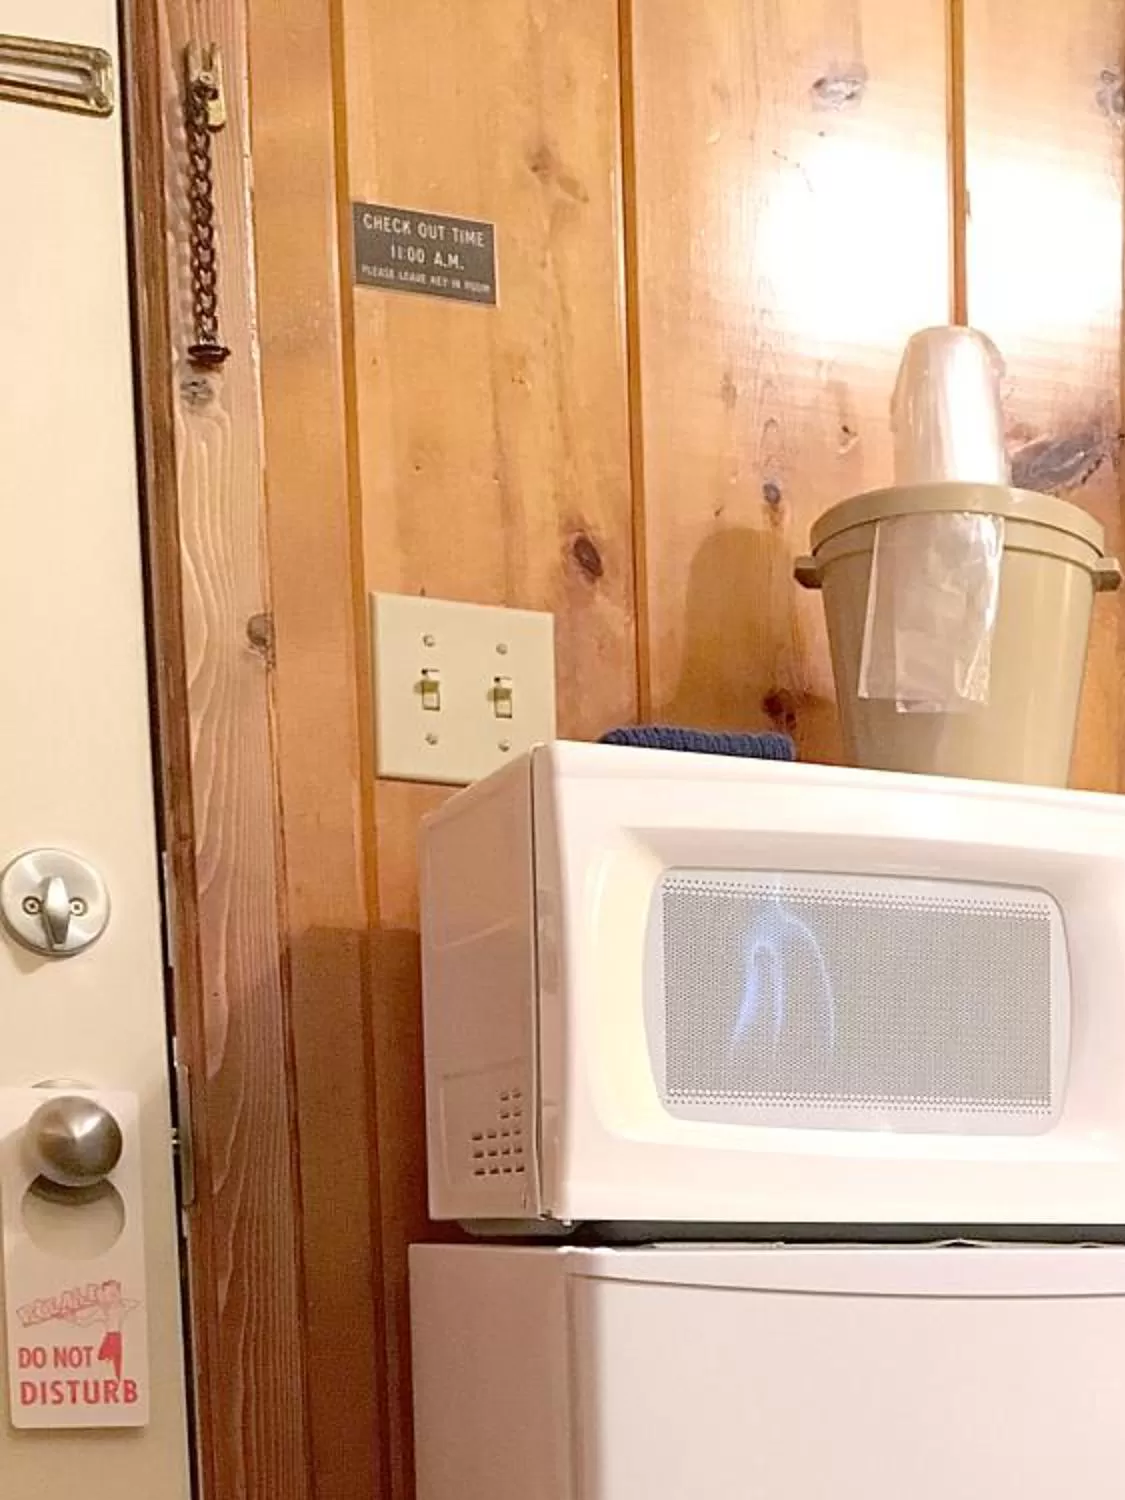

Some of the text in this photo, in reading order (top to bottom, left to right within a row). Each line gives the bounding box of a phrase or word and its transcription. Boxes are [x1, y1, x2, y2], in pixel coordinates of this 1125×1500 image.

[363, 213, 485, 248] CHECK OUT TIME
[433, 252, 465, 271] A.M.
[18, 1345, 94, 1369] DO NOT
[20, 1378, 138, 1406] DISTURB
